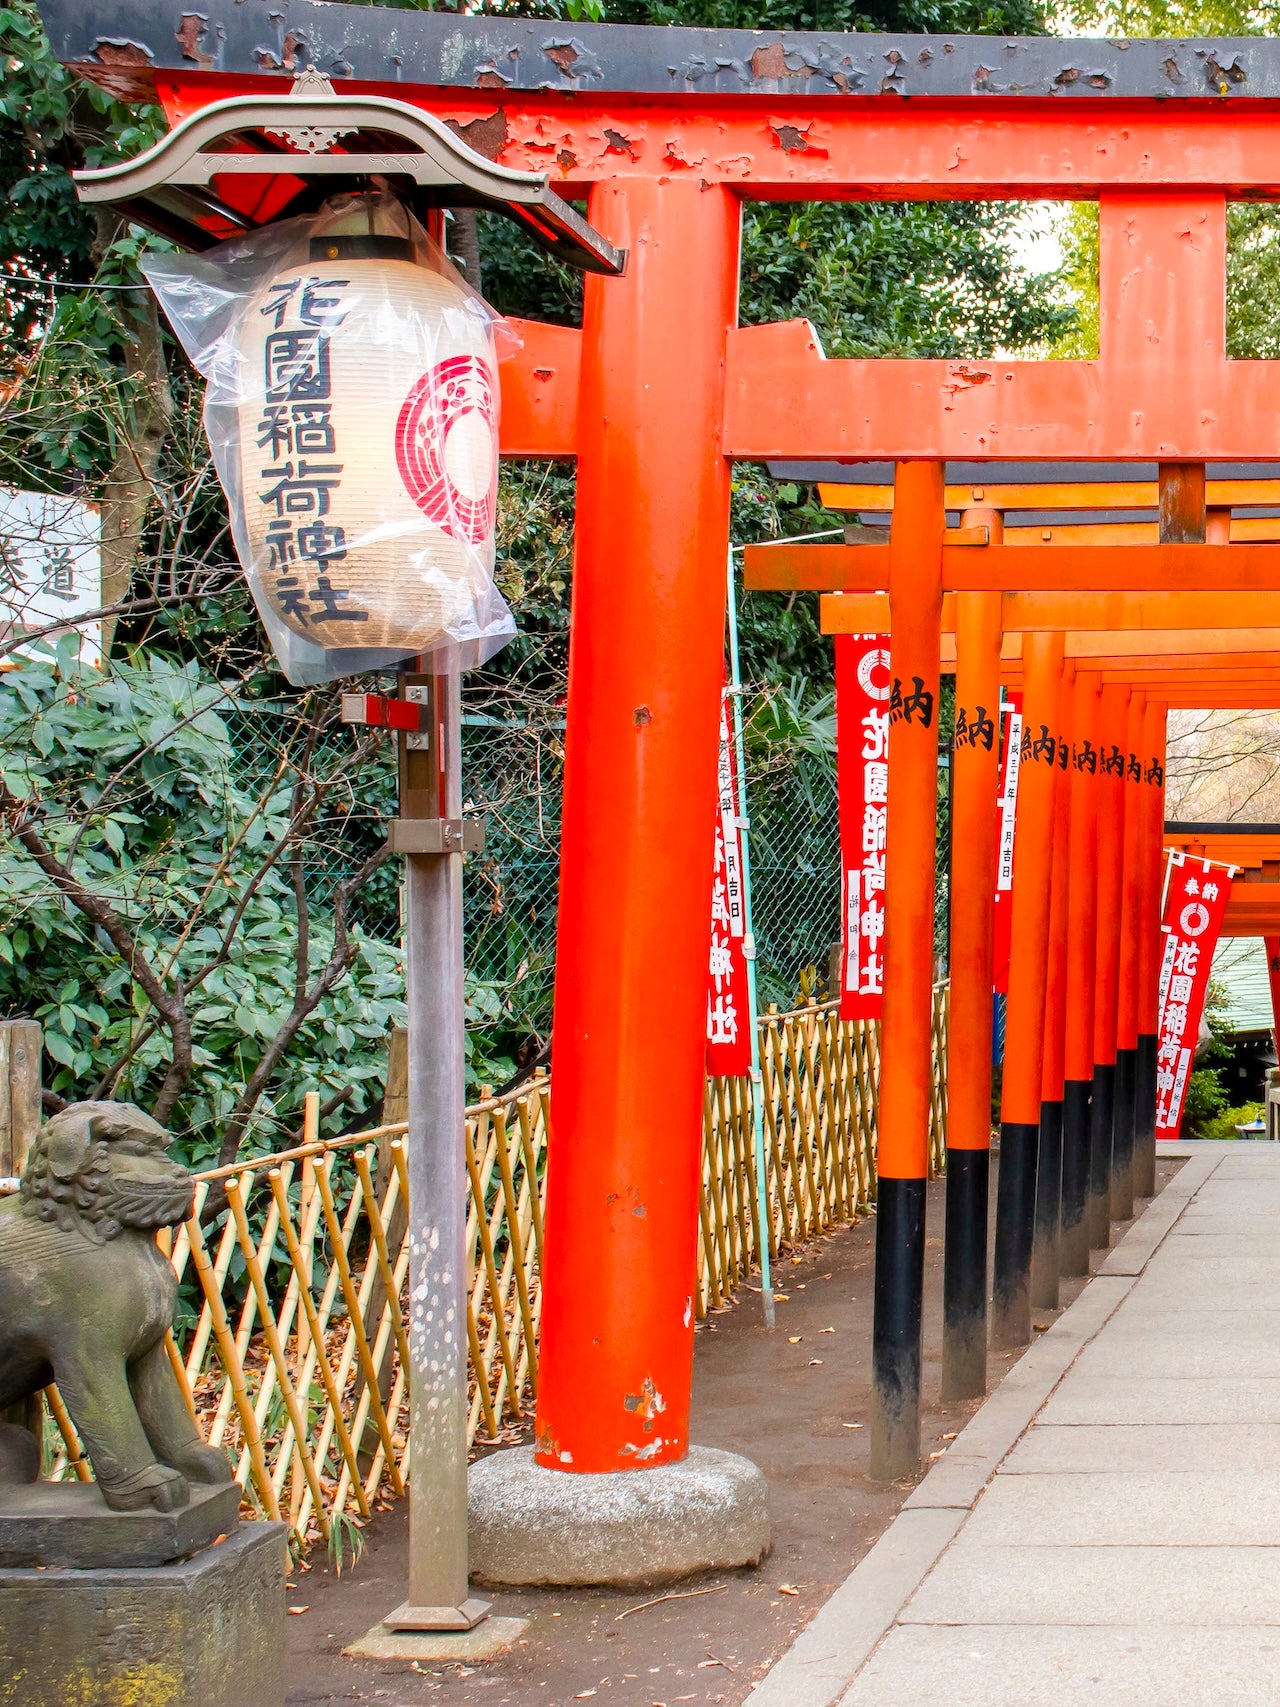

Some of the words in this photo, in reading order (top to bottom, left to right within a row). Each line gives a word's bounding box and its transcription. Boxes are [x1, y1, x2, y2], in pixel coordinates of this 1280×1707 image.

[257, 277, 369, 627] 花園稲荷神社
[889, 676, 934, 729] 納
[954, 706, 995, 752] 納
[1020, 725, 1056, 767] 納
[1184, 877, 1219, 902] 奉納
